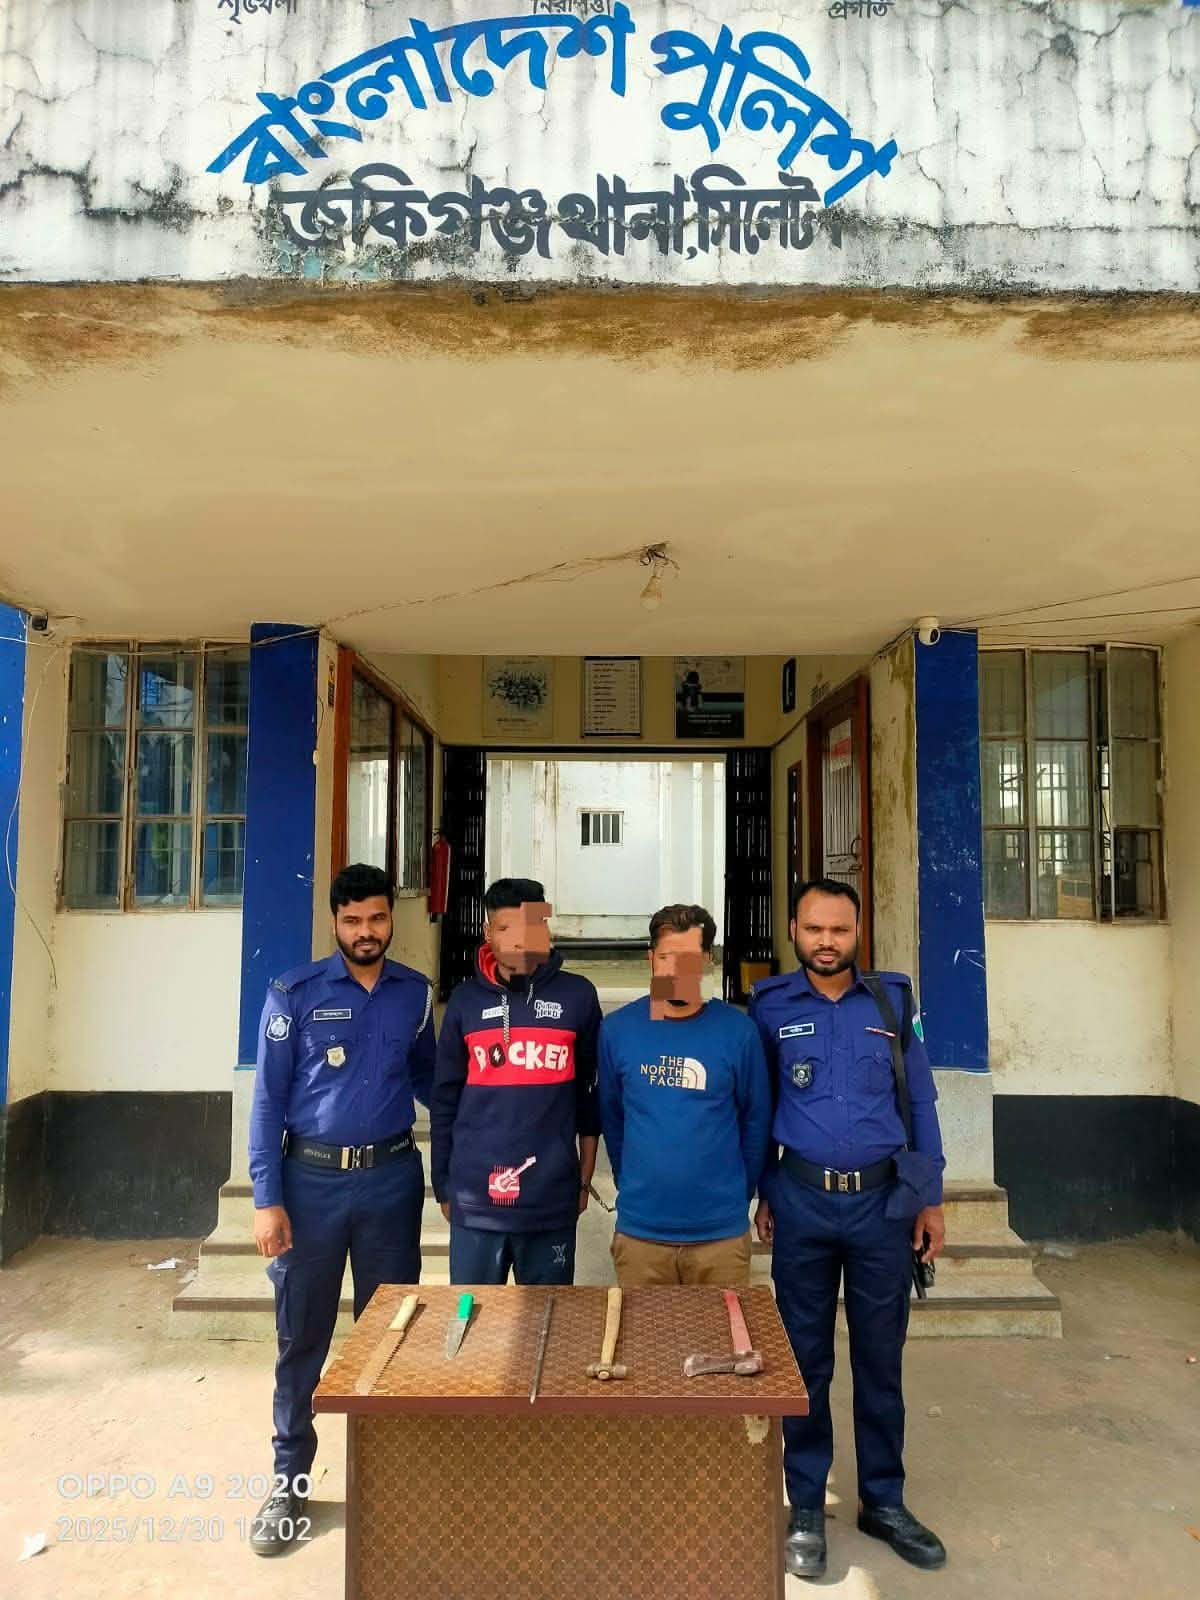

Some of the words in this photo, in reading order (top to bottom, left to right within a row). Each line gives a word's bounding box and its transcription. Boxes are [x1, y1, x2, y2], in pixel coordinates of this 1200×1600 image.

[206, 1, 636, 184] বাংলাদেশ
[650, 24, 898, 208] পুলিশ
[660, 1055, 683, 1067] THE
[640, 1063, 683, 1077] NORTH
[649, 1075, 682, 1087] FACE
